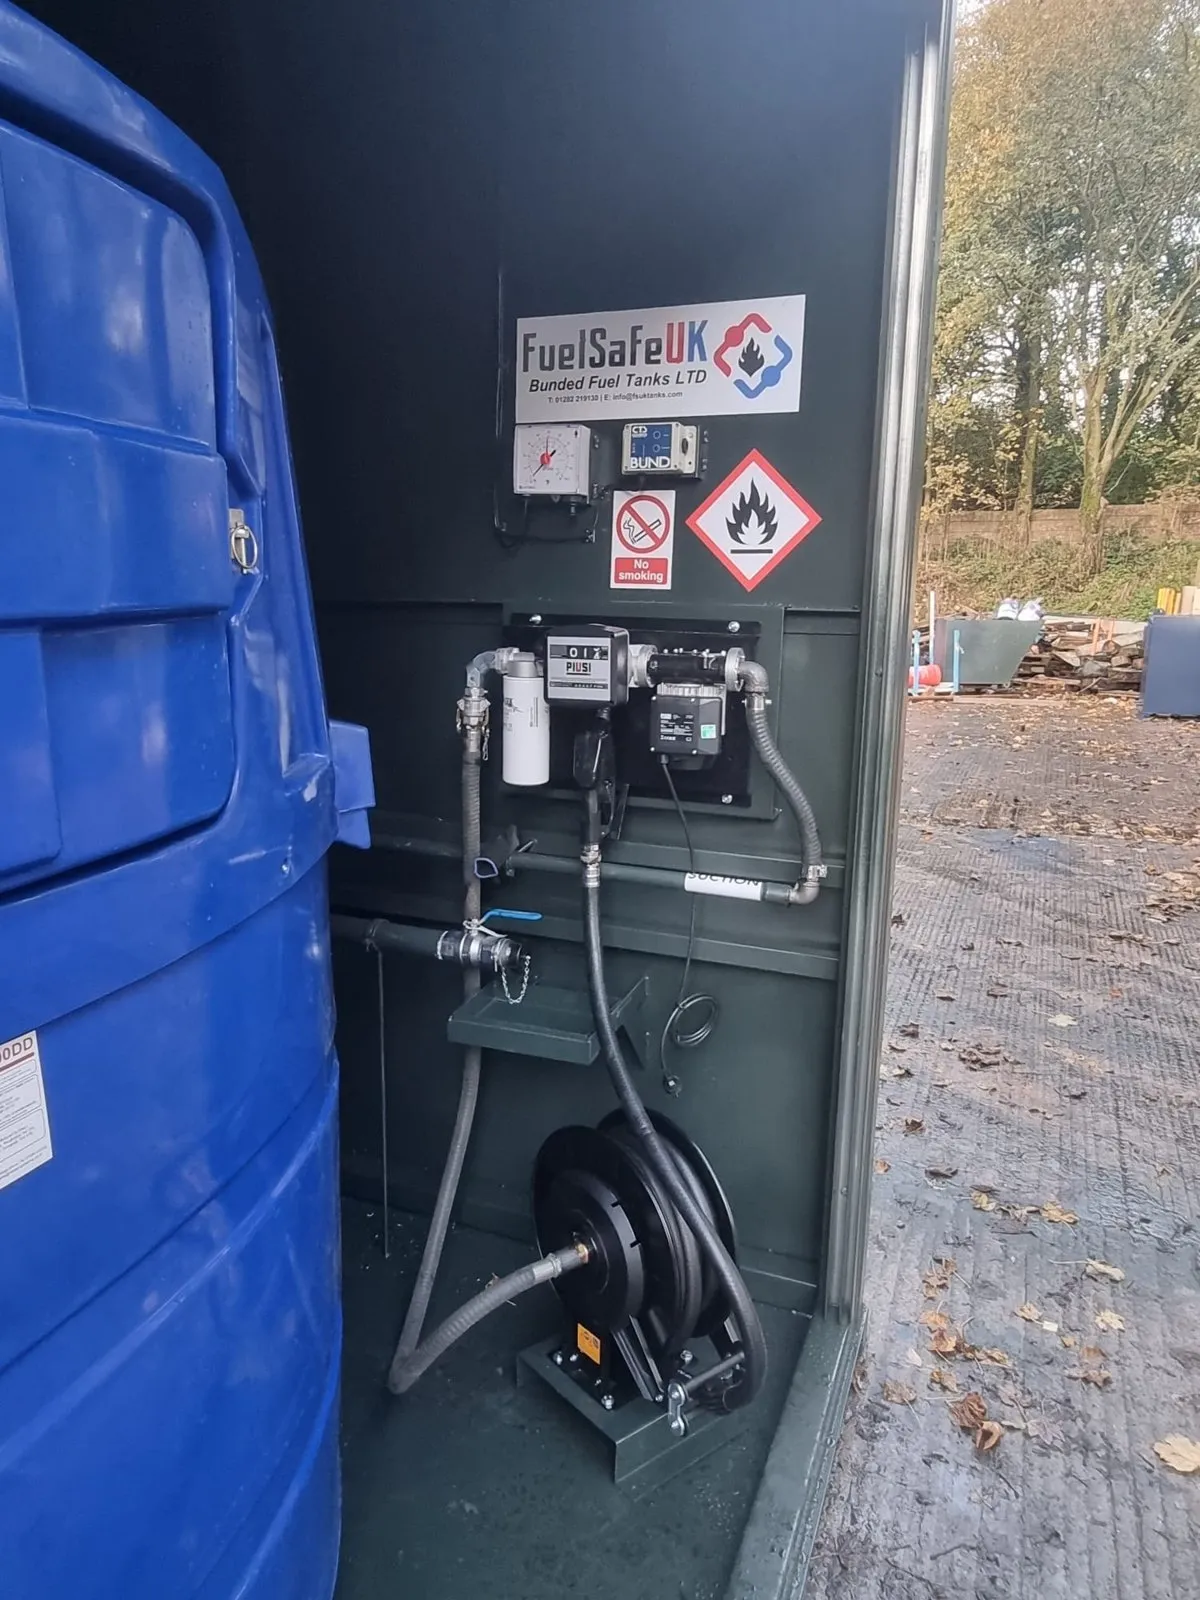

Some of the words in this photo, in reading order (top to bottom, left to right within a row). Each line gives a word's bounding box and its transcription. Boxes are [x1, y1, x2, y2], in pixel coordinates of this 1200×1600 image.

[529, 377, 585, 392] Bunded
[588, 374, 620, 388] Fuel
[626, 372, 670, 387] Tanks
[675, 369, 708, 385] LTD
[630, 456, 671, 469] BUND
[633, 559, 650, 570] No
[618, 570, 664, 583] smoking
[566, 662, 591, 672] PIUSI
